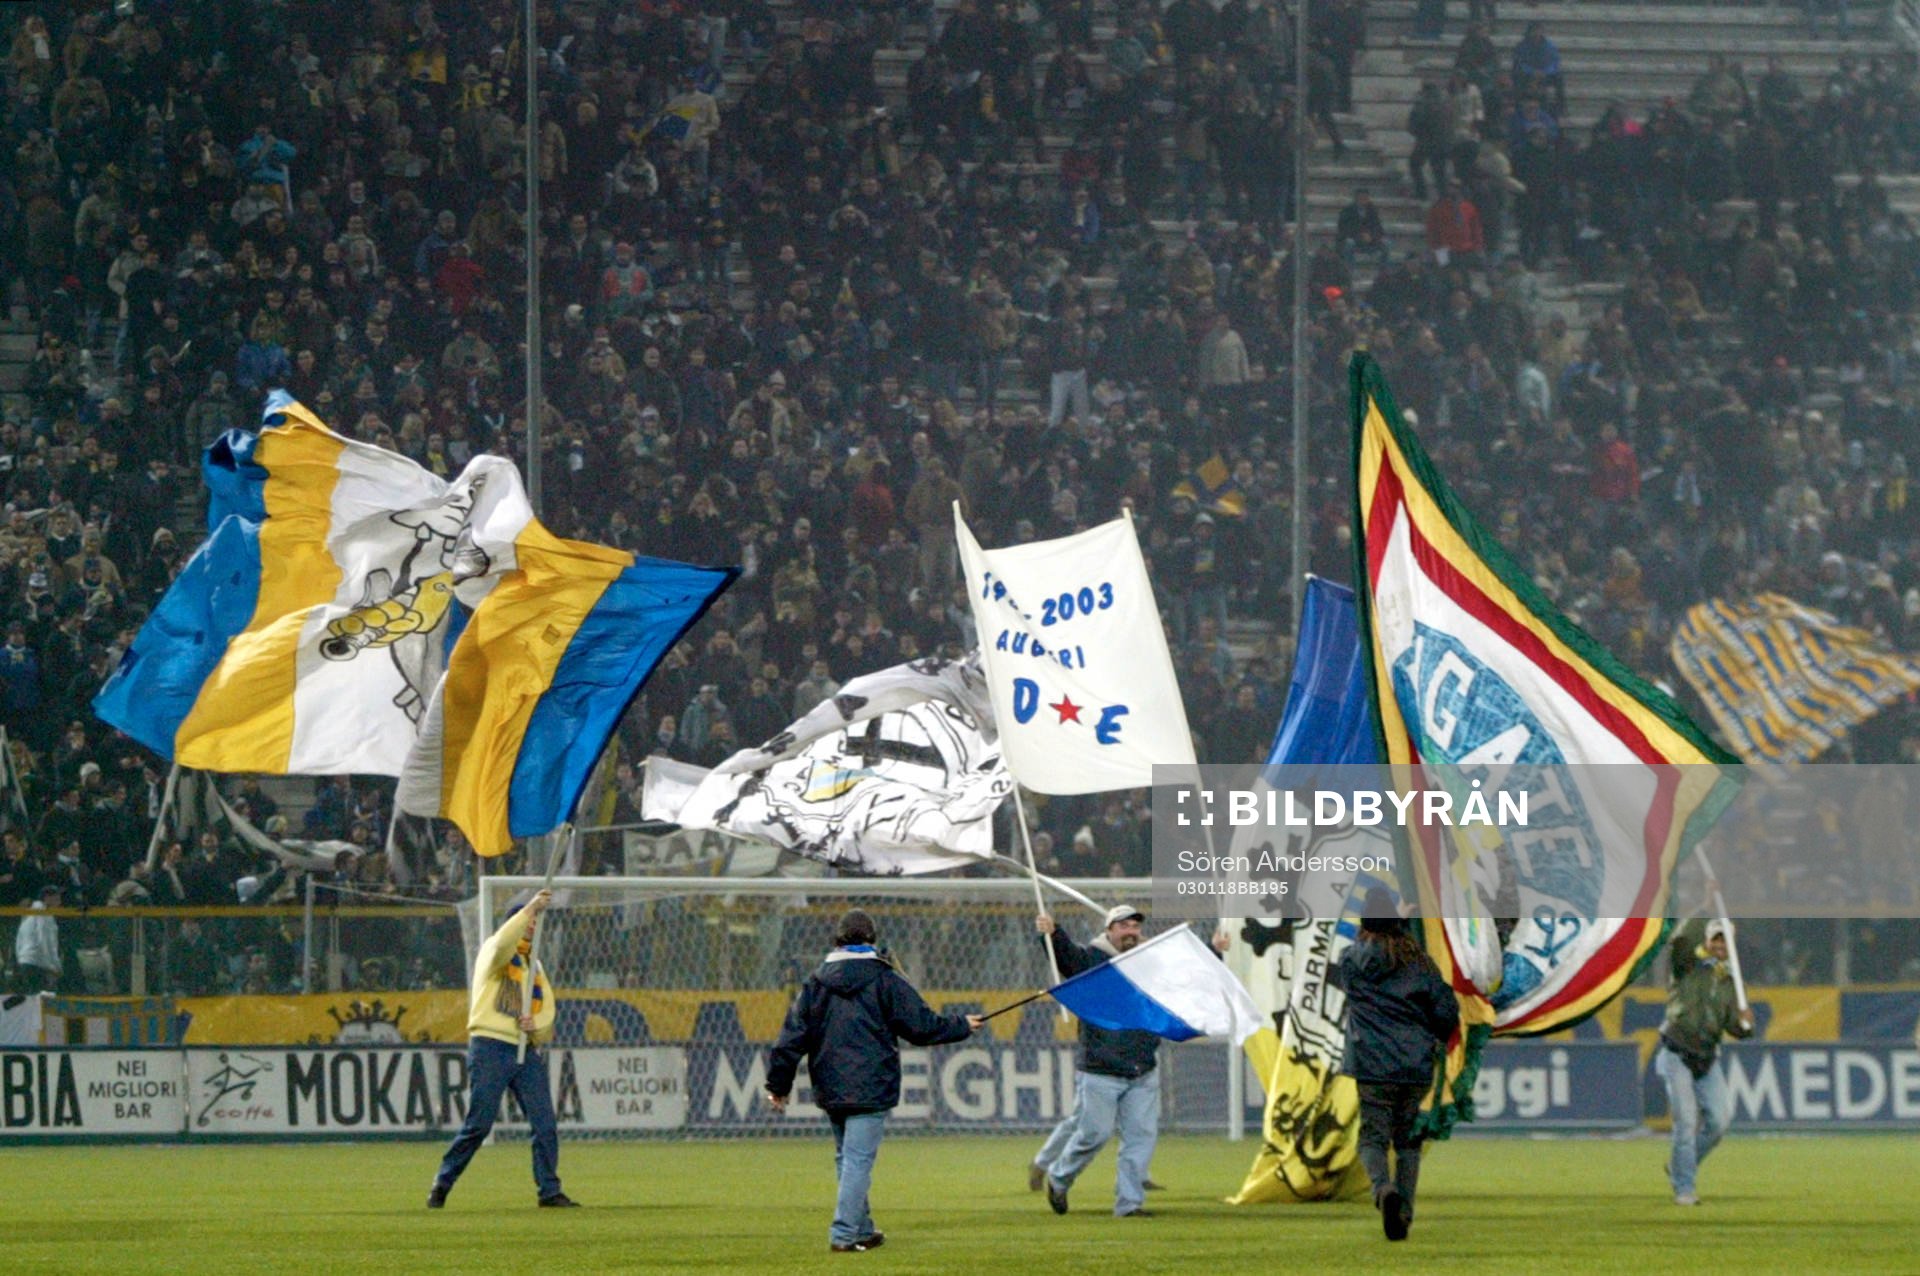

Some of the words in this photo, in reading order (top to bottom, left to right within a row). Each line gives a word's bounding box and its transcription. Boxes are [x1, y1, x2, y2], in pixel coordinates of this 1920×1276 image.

[1040, 582, 1114, 626] 2003
[117, 1060, 147, 1077] NEI
[617, 1057, 649, 1074] NEI
[0, 1053, 83, 1127] BIA
[88, 1081, 177, 1098] MIGLIORI
[286, 1051, 585, 1126] MOKARA
[590, 1077, 678, 1095] MIGLIORI
[1473, 1050, 1570, 1118] ggi
[115, 1103, 152, 1119] BAR
[616, 1098, 654, 1115] BAR
